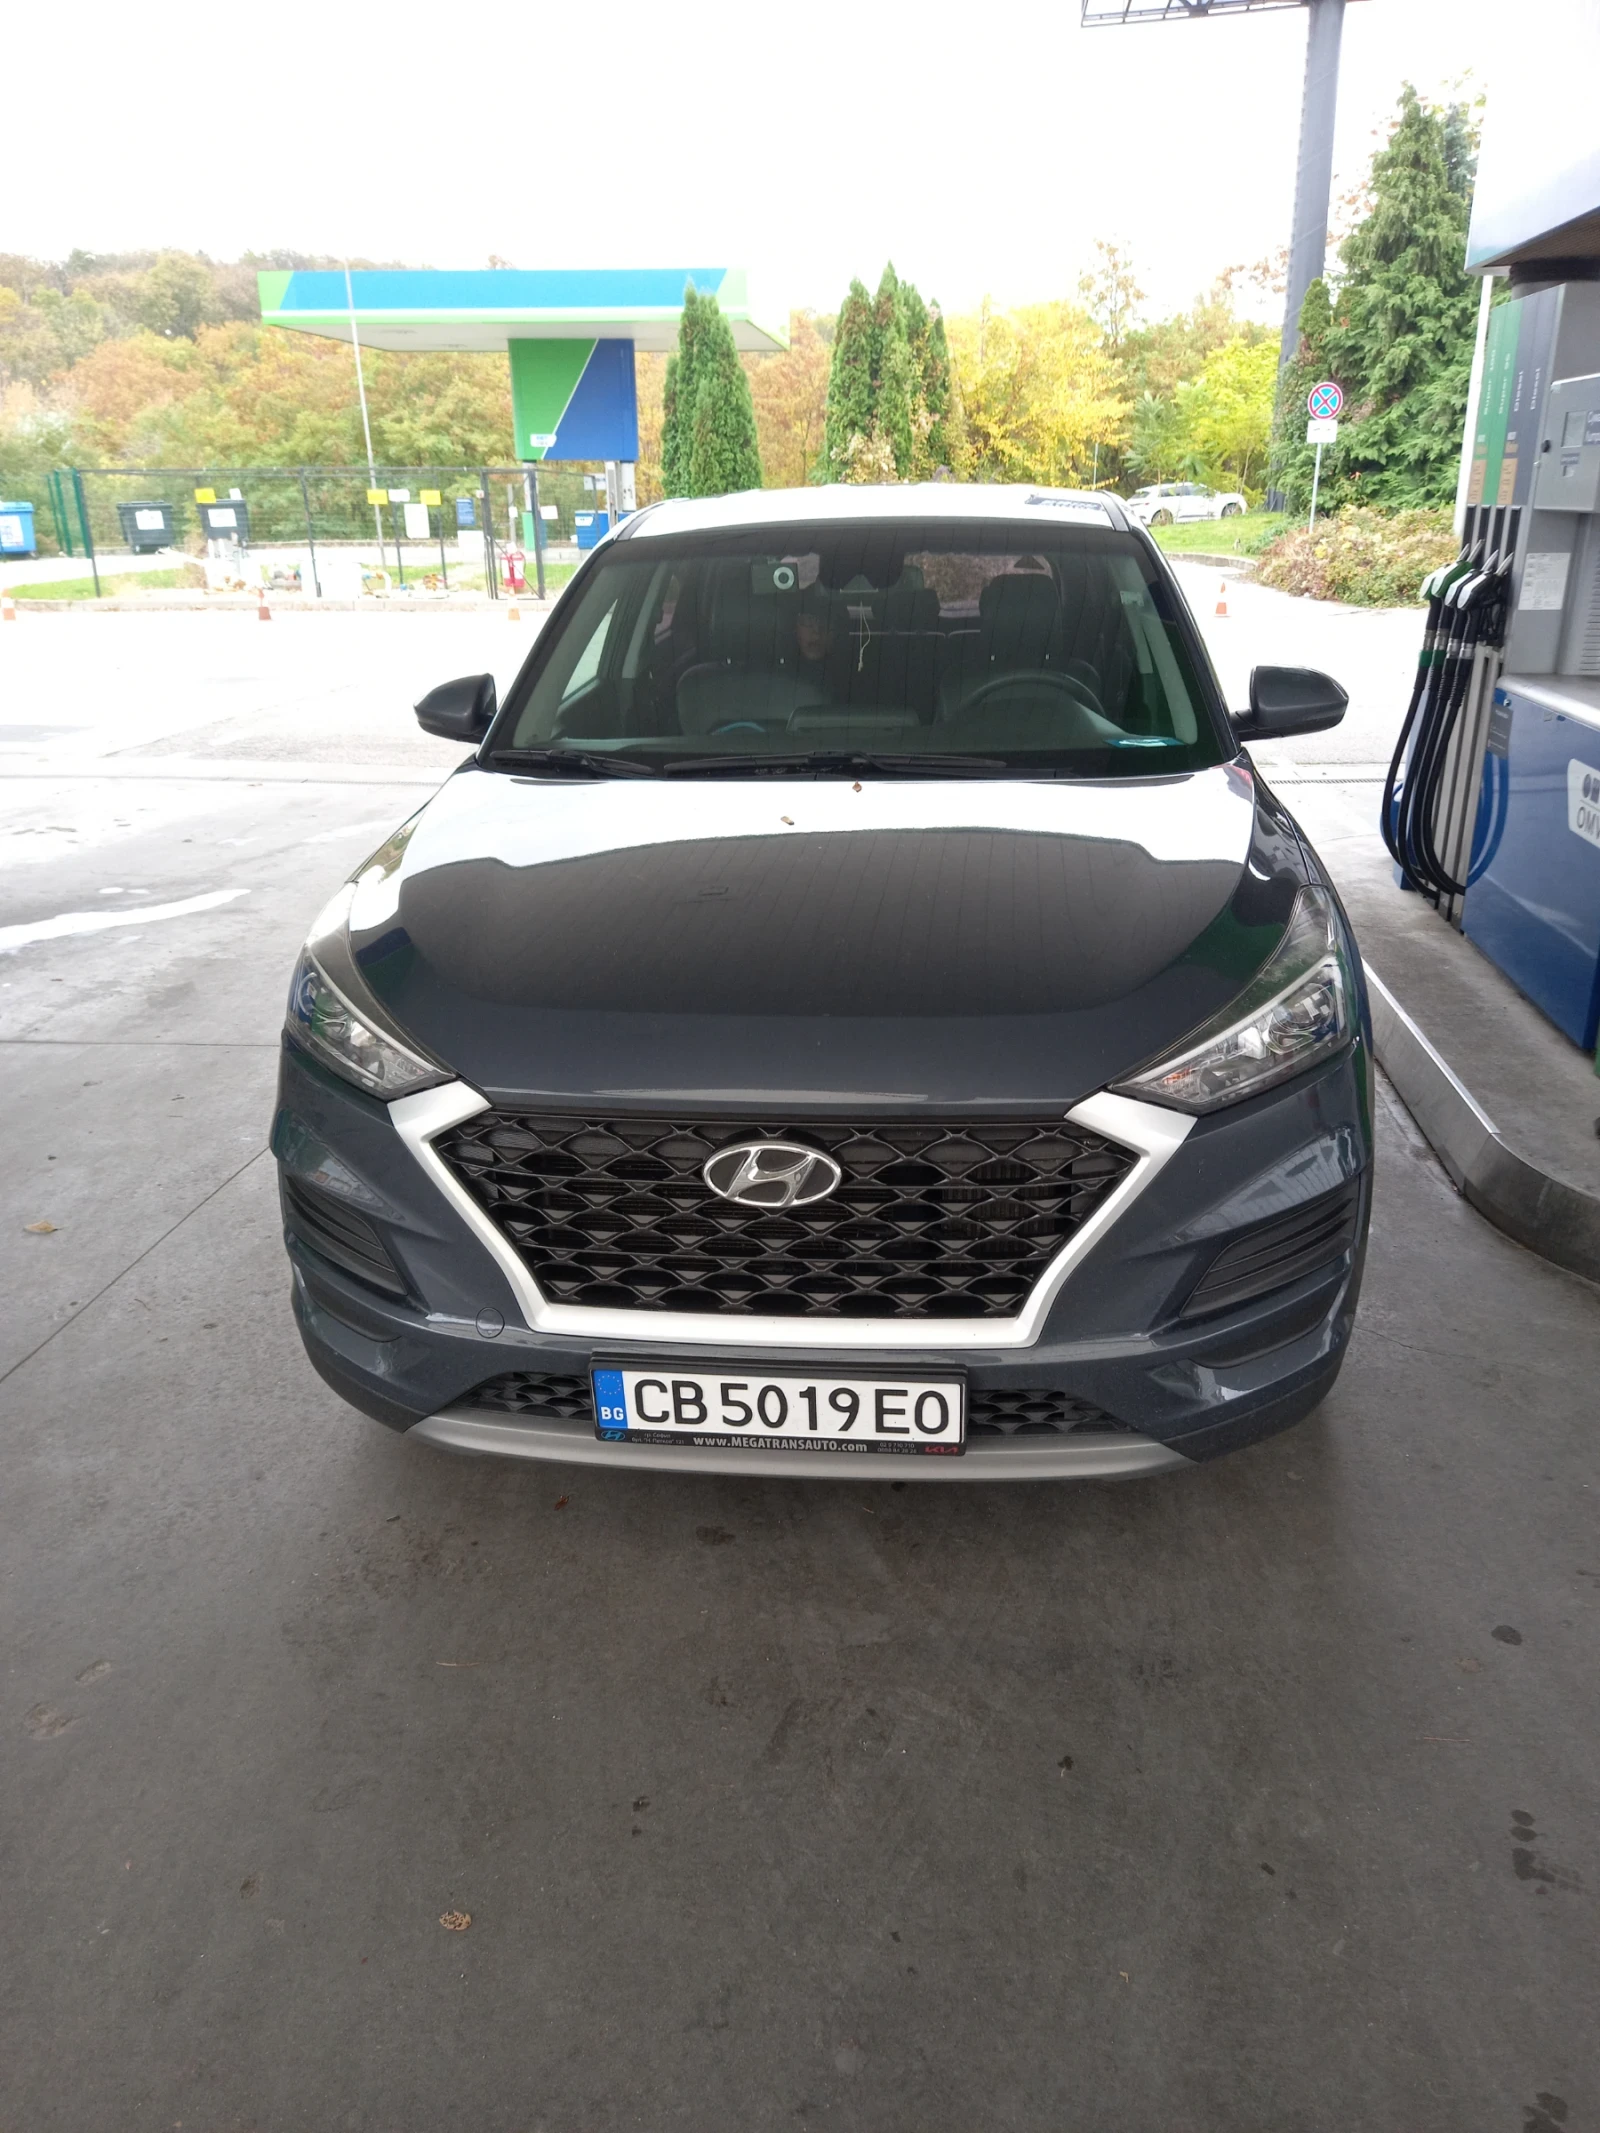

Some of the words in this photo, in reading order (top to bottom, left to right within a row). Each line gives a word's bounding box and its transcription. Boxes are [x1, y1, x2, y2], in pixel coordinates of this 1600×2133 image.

[1513, 370, 1524, 412] Diesel
[1530, 367, 1541, 410] Diesel
[600, 1406, 624, 1421] BG
[693, 1435, 868, 1453] www.MEGATRANSAUTO.com
[924, 1445, 959, 1455] KIA
